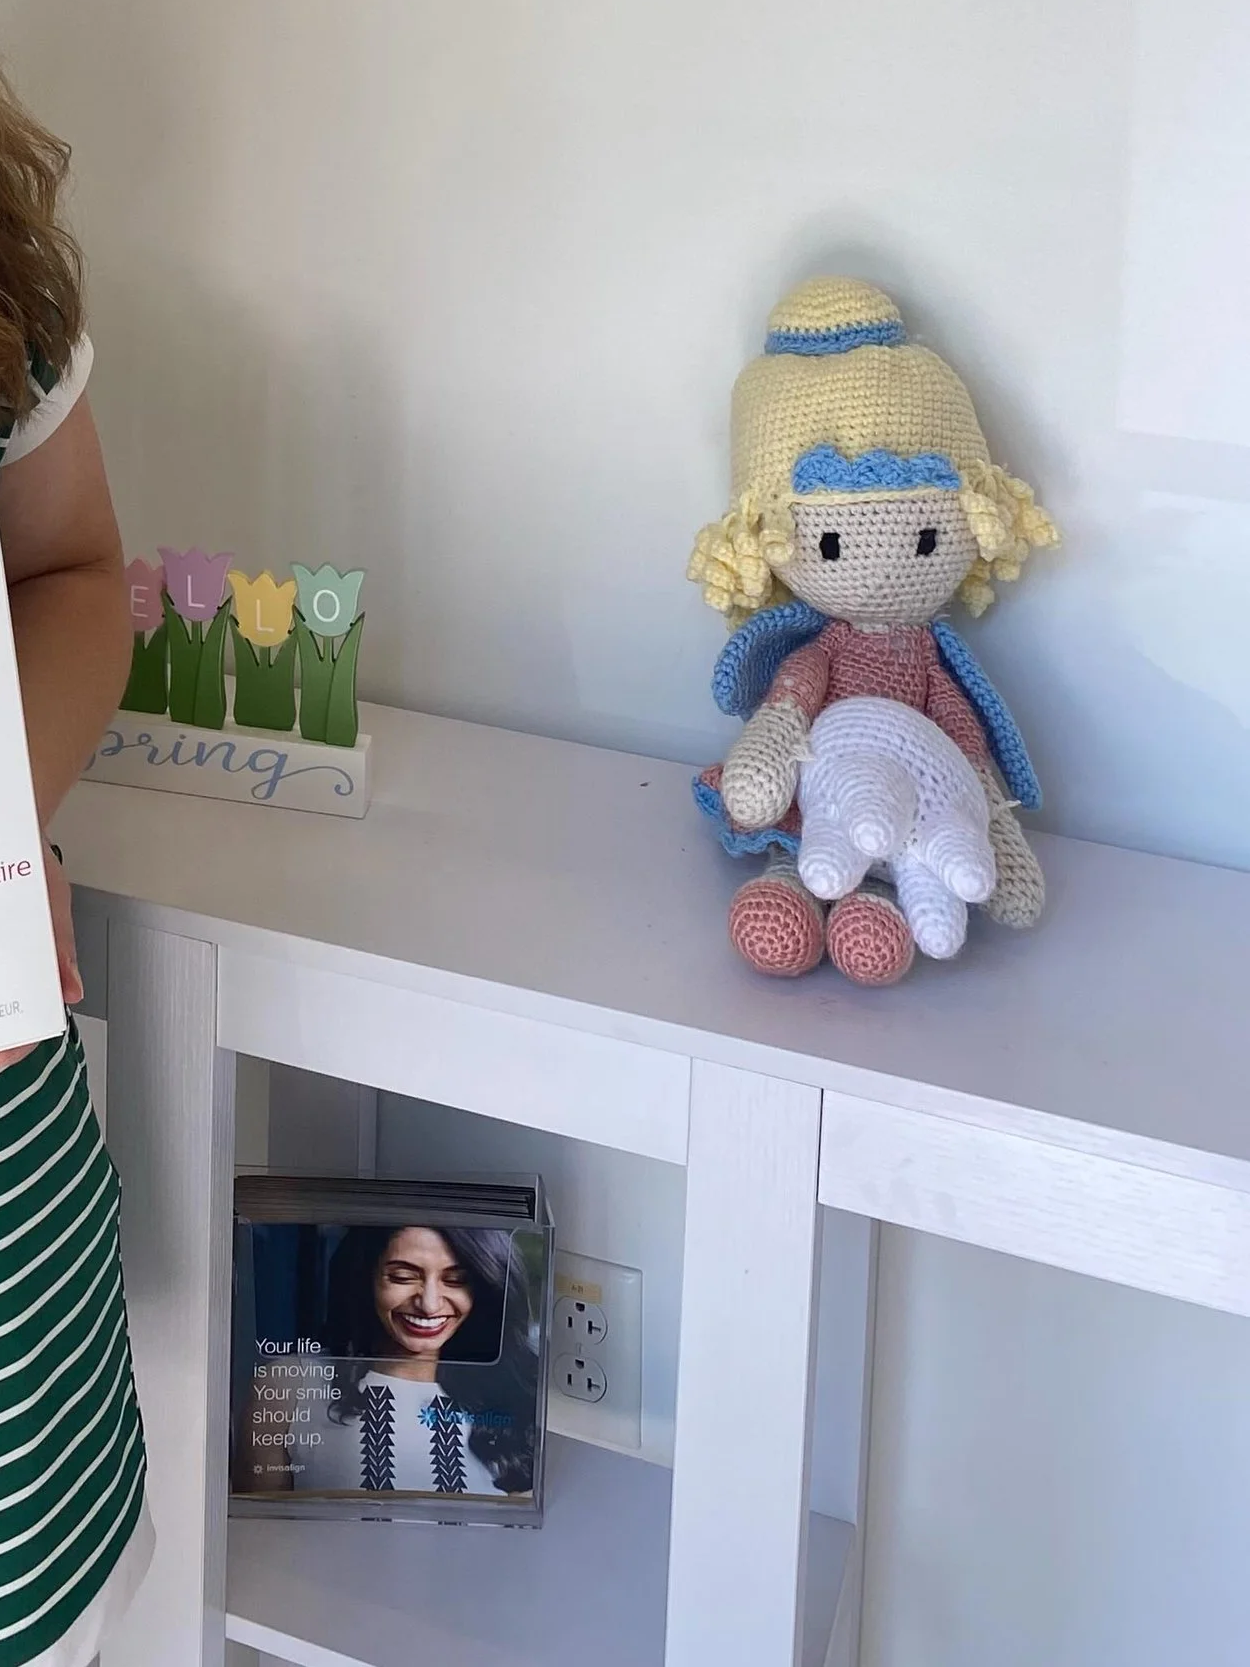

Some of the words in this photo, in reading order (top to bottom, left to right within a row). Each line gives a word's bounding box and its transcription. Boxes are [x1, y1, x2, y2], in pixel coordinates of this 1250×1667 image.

[129, 574, 340, 633] ELLO
[84, 730, 354, 800] pring
[255, 1338, 293, 1354] Your
[297, 1338, 321, 1354] life
[253, 1363, 267, 1378] is
[271, 1363, 339, 1381] moving.
[254, 1385, 292, 1401] Your
[296, 1384, 341, 1400] smile
[253, 1407, 310, 1424] should
[252, 1431, 295, 1448] keep
[300, 1432, 325, 1448] up.
[267, 1464, 306, 1474] invisalign
